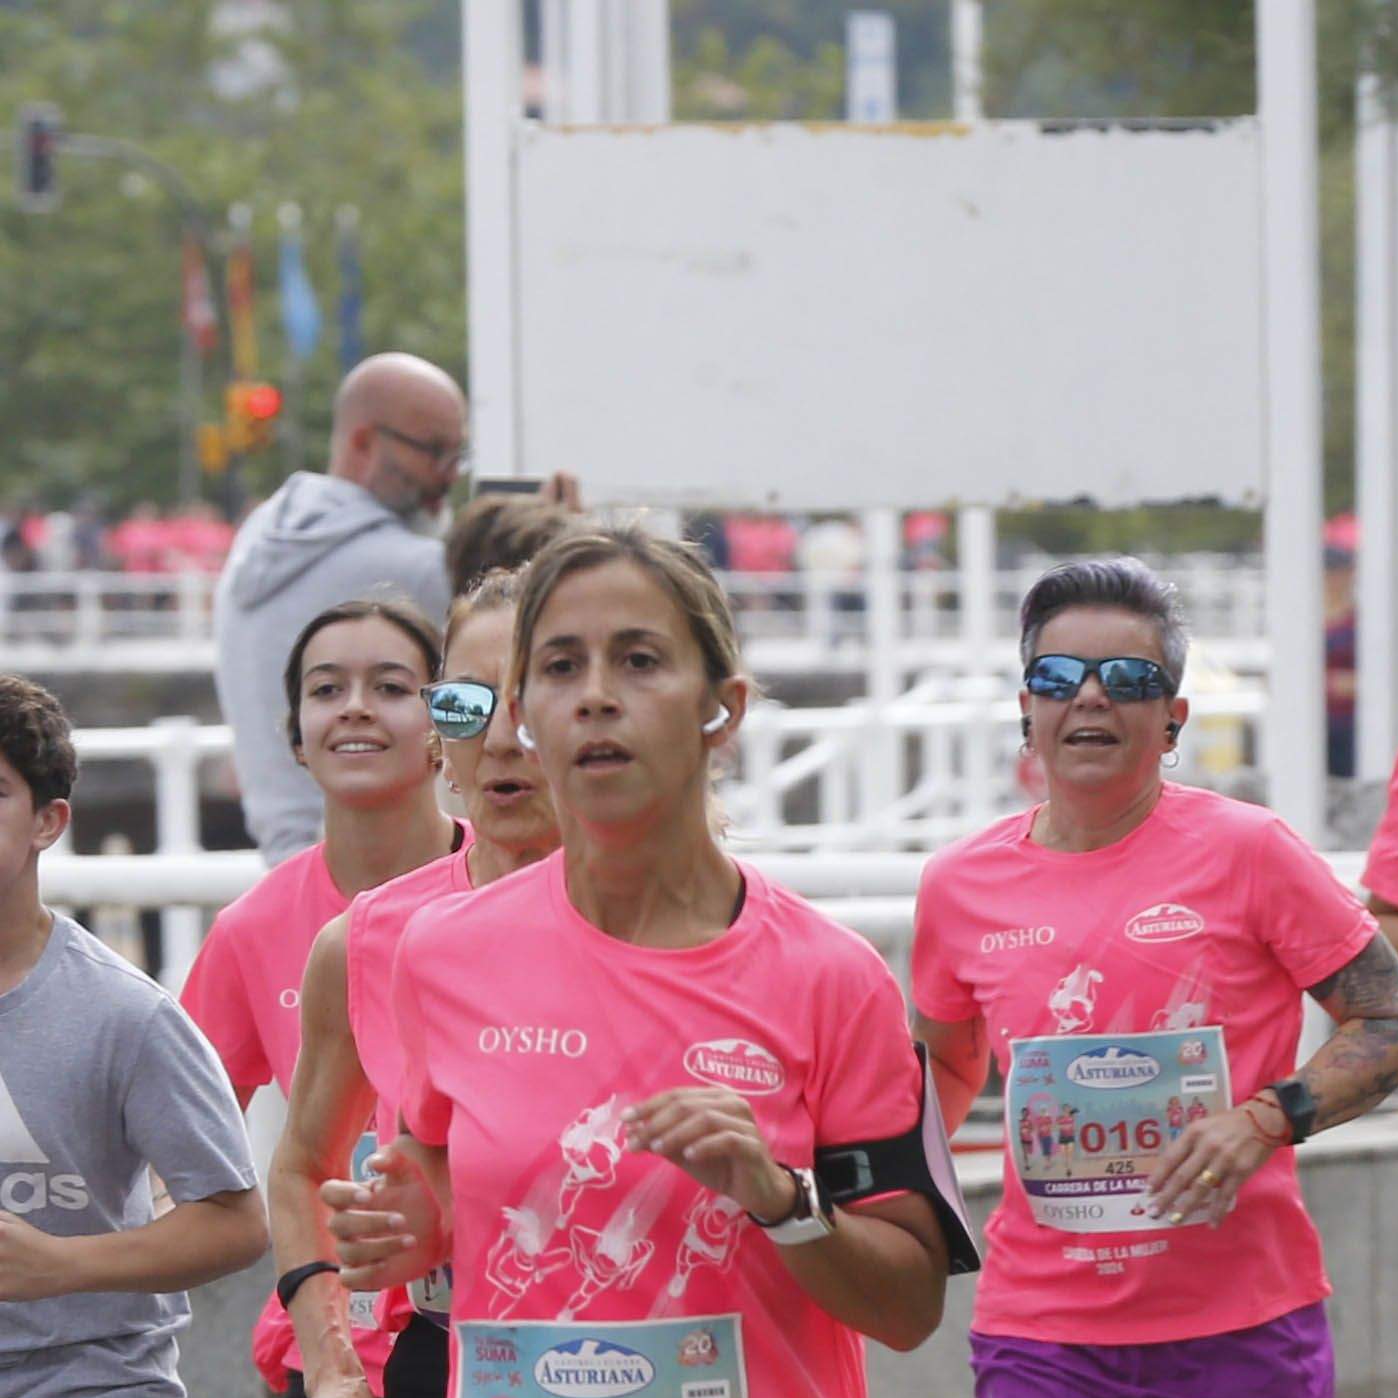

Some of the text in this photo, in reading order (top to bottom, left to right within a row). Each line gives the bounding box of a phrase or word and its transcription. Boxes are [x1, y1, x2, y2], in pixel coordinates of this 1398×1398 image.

[979, 925, 1056, 954] OYSHO
[478, 1025, 588, 1058] OYSHO
[1073, 1062, 1155, 1081] ASTURIANA
[1079, 1119, 1162, 1154] 016
[1104, 1160, 1135, 1175] 425
[540, 1360, 647, 1386] ASTURIANA
